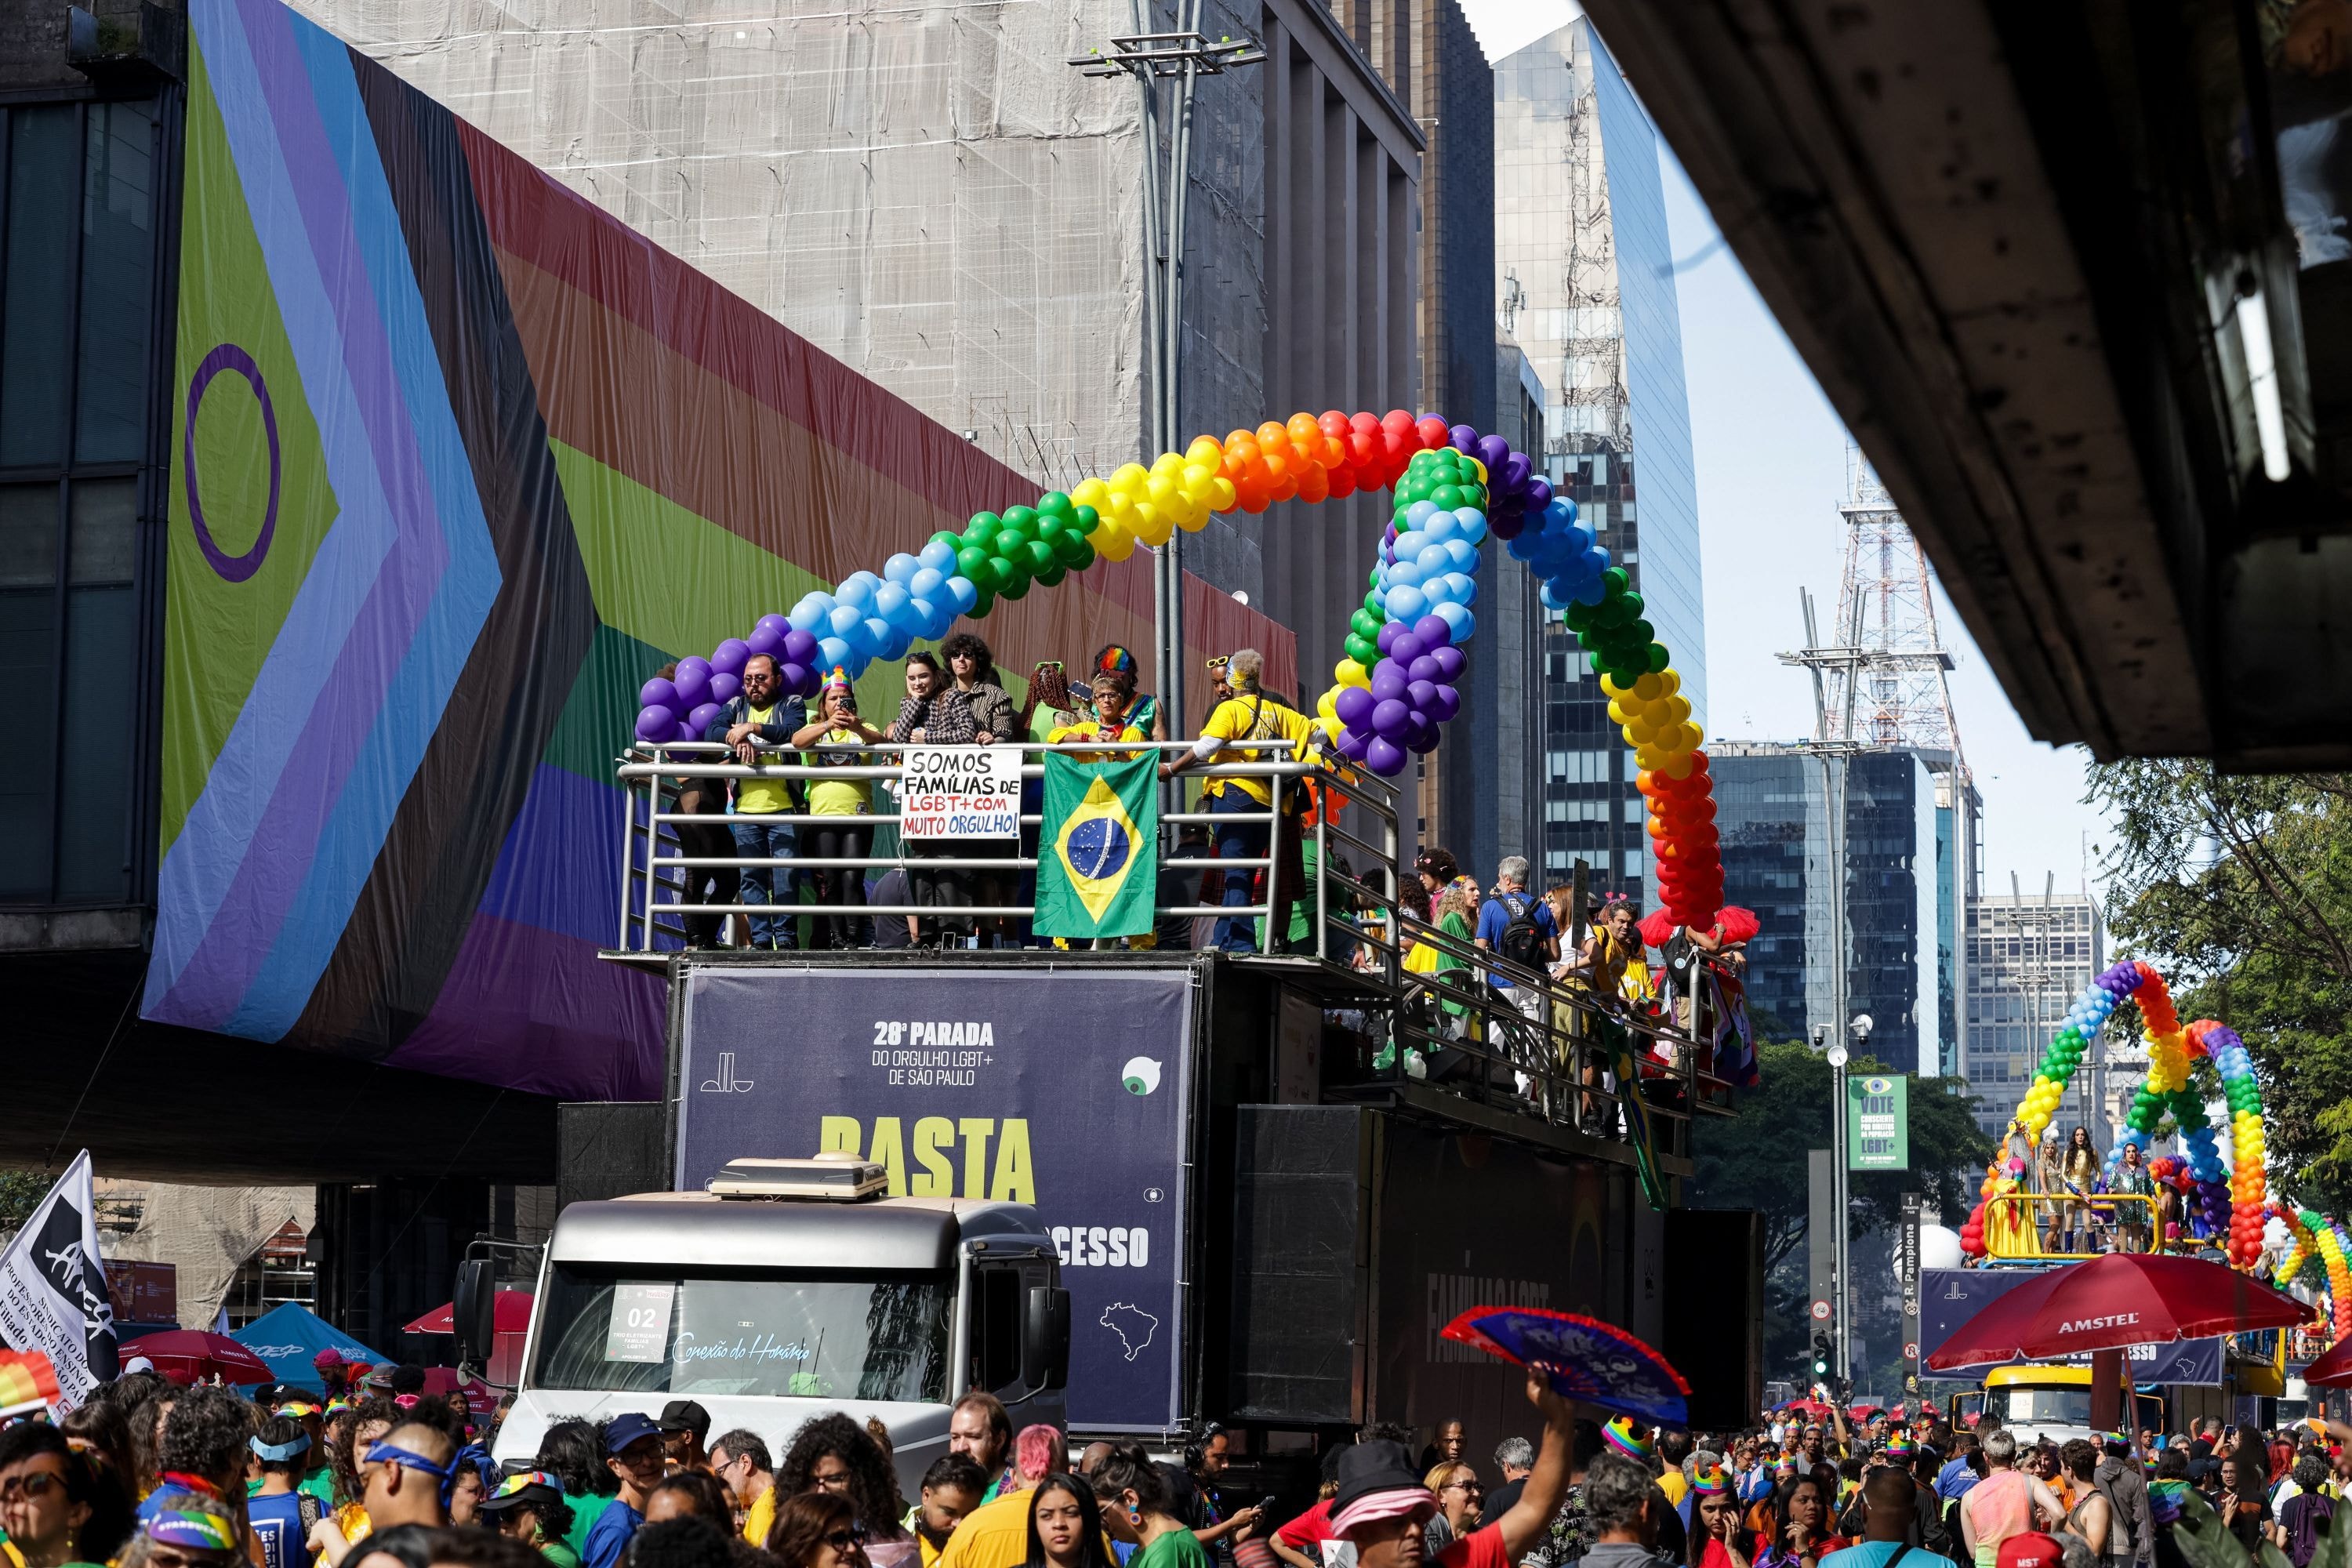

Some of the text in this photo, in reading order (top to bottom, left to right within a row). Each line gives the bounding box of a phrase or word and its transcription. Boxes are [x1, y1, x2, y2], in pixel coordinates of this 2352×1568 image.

[911, 752, 992, 774] SOMOS
[905, 773, 1018, 795] FAMÍLIAS DE
[902, 812, 1018, 837] MUITO ORGULHO!
[873, 1022, 993, 1046] 28ª PARADA
[872, 1051, 993, 1067] DO ORGULHO LGBT+
[889, 1067, 975, 1086] DE SÃO PAULO
[1860, 1096, 1894, 1113] VOTE
[1861, 1139, 1895, 1153] LGBT+
[1045, 1226, 1149, 1267] CESSO
[1904, 1224, 1915, 1295] R. Pamplona
[5, 1260, 88, 1387] PROFESSORES DO ENSINO
[38, 1295, 77, 1355] SINDICATO
[627, 1308, 656, 1328] 02
[2058, 1312, 2140, 1334] AMSTEL
[7, 1289, 19, 1307] DO
[19, 1306, 47, 1346] ESTADO
[52, 1362, 68, 1385] SÃO
[67, 1383, 85, 1405] PAU
[220, 1349, 250, 1360] AMSTEL
[672, 1332, 810, 1366] Conexão do Horário
[2017, 1558, 2039, 1567] MST
